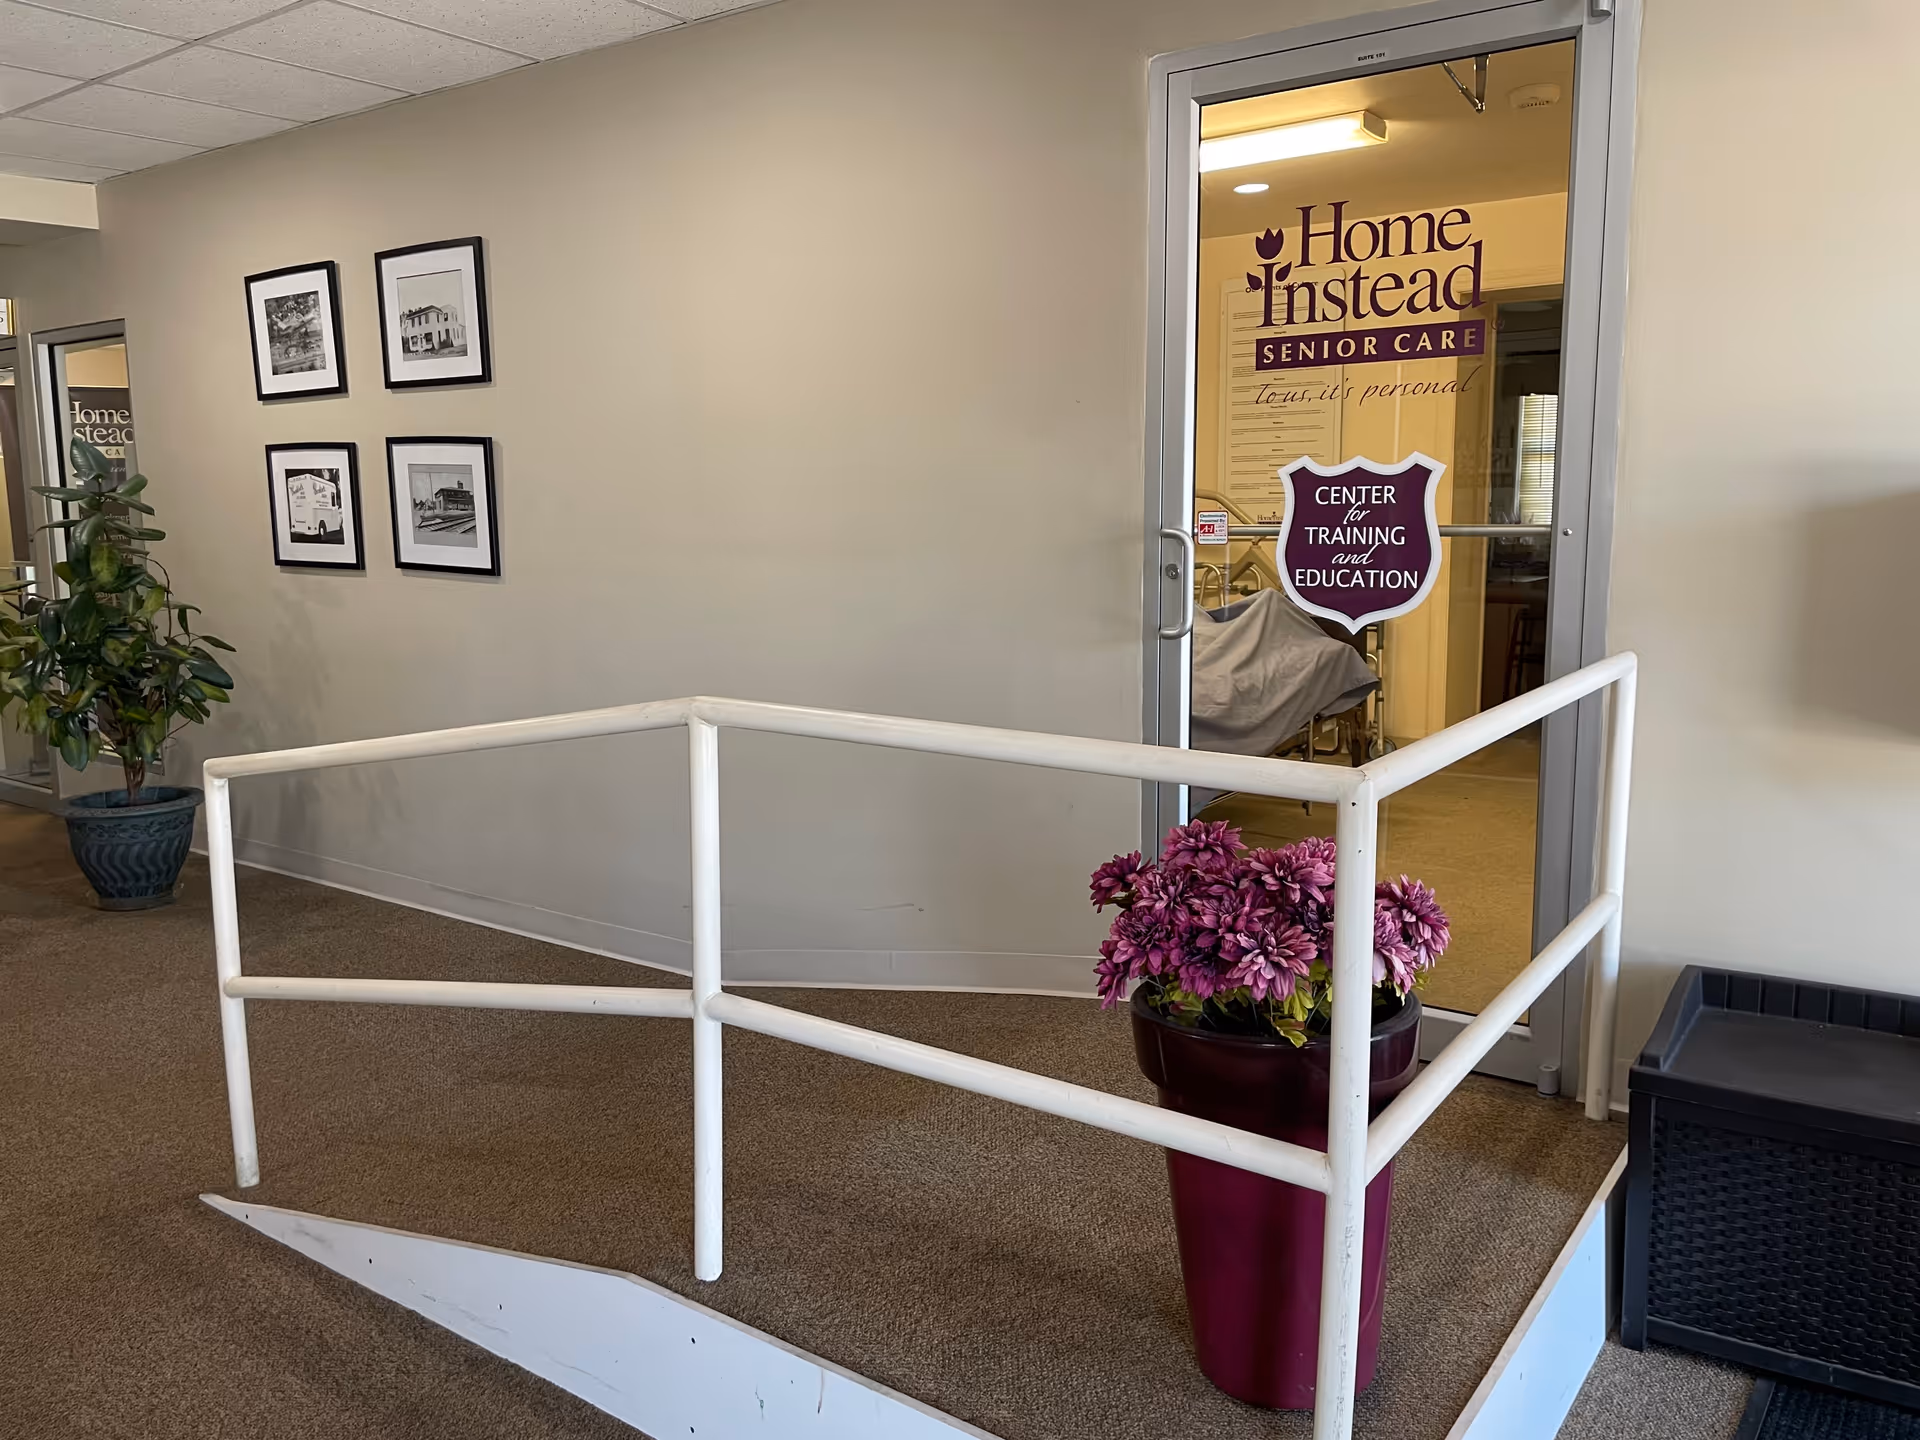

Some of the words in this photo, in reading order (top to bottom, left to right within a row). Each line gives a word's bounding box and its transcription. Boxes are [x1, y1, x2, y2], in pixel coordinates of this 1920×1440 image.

[1295, 200, 1472, 268] Home
[1256, 239, 1487, 327] Instead
[1263, 337, 1377, 363] SENIOR
[1394, 327, 1476, 353] CARE
[1255, 383, 1277, 404] To
[1283, 389, 1312, 403] us,
[1319, 377, 1354, 401] it's
[1359, 365, 1483, 406] personal
[1315, 485, 1396, 505] CENTER
[1343, 501, 1370, 524] for
[1304, 526, 1406, 545] TRAINING
[1332, 542, 1381, 564] and
[1295, 568, 1418, 588] EDUCATION
